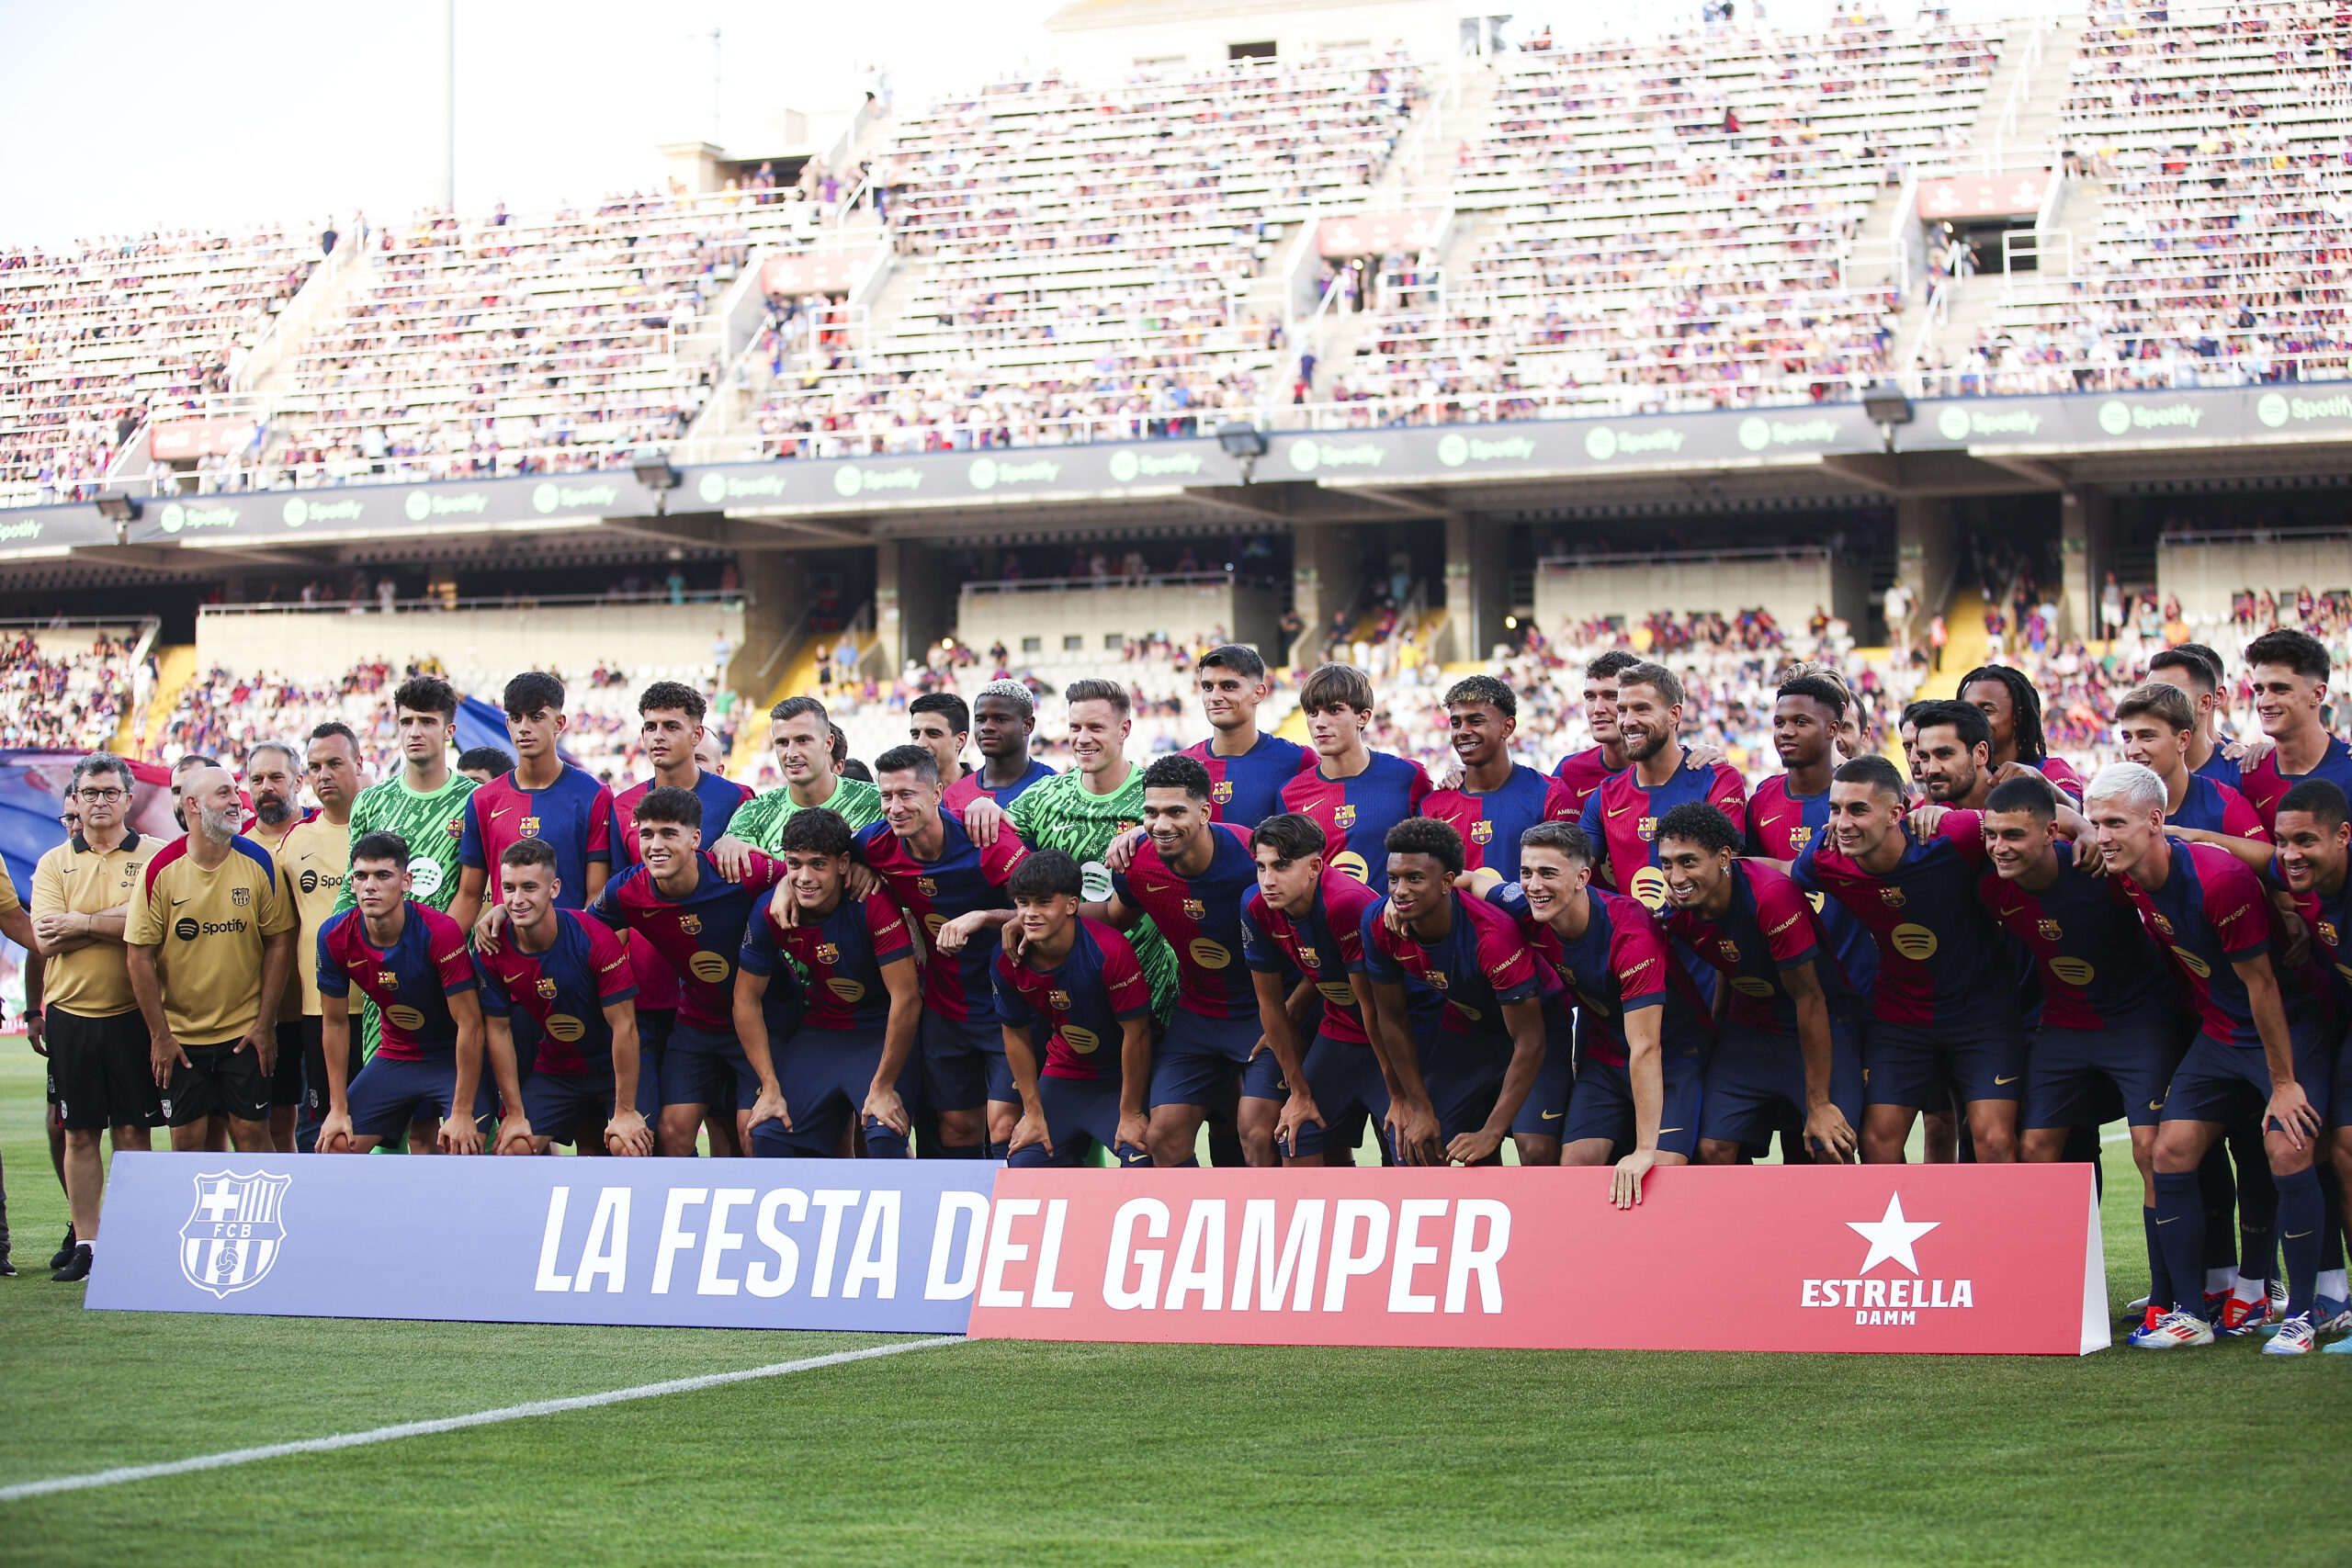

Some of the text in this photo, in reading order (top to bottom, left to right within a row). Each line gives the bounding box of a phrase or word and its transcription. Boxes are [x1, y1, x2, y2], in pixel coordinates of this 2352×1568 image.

[1971, 411, 2042, 435] Spotify
[2132, 403, 2203, 430] Spotify
[185, 506, 240, 530] Spotify
[202, 919, 247, 935] Spotify
[874, 918, 903, 936] AMBILIGHT
[1768, 912, 1799, 936] AMBILIGHT
[1492, 949, 1522, 974] AMBILIGHT
[1619, 959, 1651, 979] AMBILIGHT
[212, 1223, 253, 1238] FCB
[535, 1186, 1511, 1314] LA FESTA DEL GAMPER
[1800, 1279, 1974, 1308] ESTRELLA
[1855, 1310, 1917, 1325] DAMM
